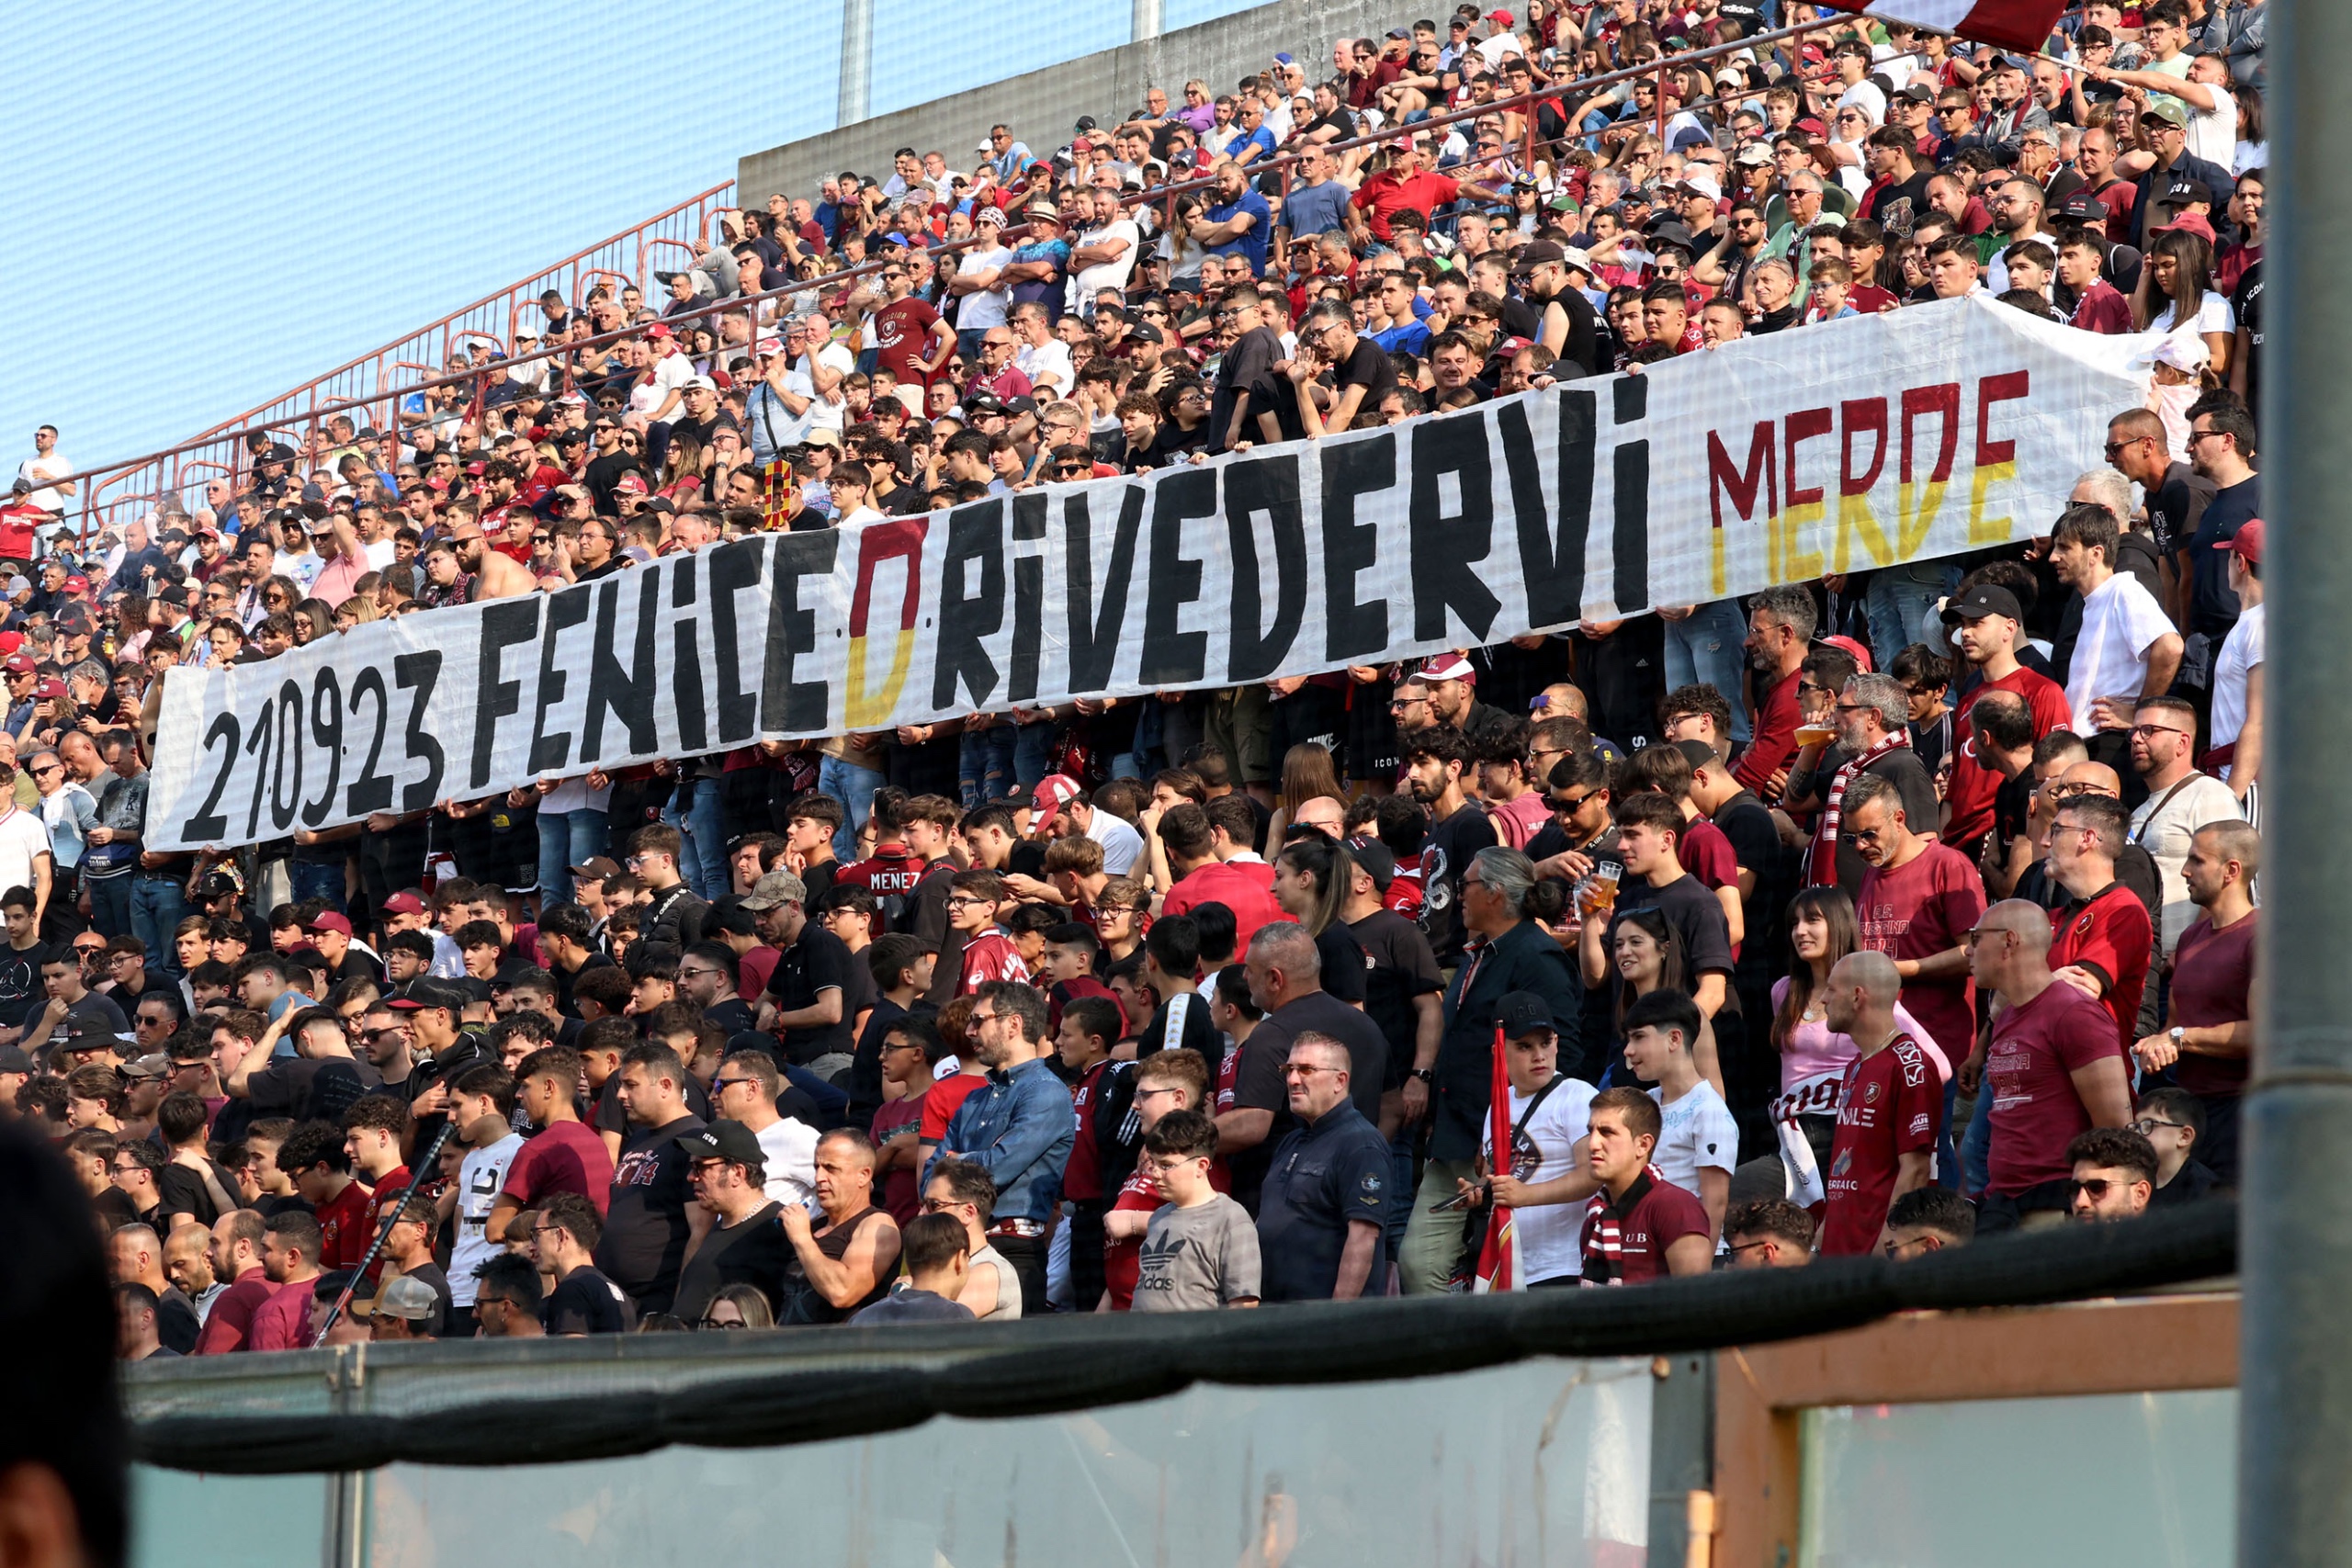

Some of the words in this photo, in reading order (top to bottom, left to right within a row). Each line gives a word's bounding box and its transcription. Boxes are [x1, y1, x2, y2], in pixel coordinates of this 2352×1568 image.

[1721, 4, 1755, 15] adidas
[1707, 369, 2030, 595] MERDE
[1374, 757, 1400, 768] ICON
